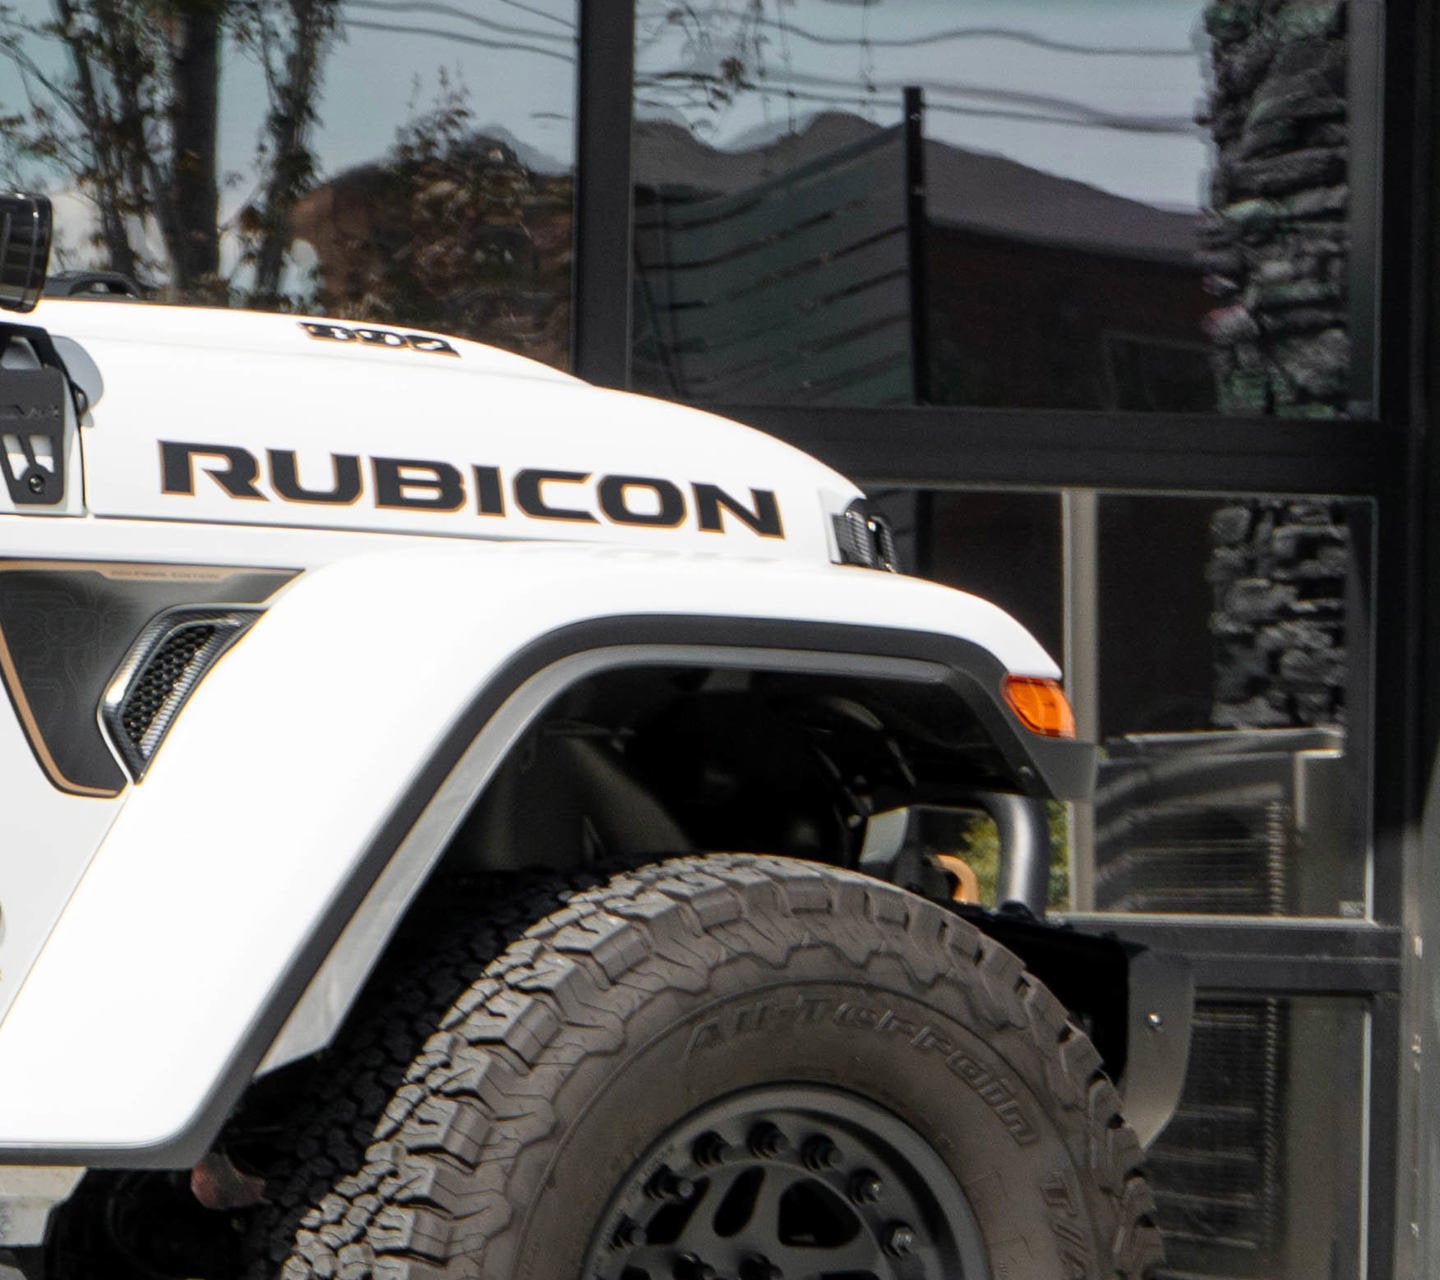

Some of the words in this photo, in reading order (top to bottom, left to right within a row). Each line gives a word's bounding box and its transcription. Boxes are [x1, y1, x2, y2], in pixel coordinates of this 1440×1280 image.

[297, 322, 461, 358] 392
[157, 439, 785, 540] RUBICON
[684, 992, 1041, 1147] All-Terrain
